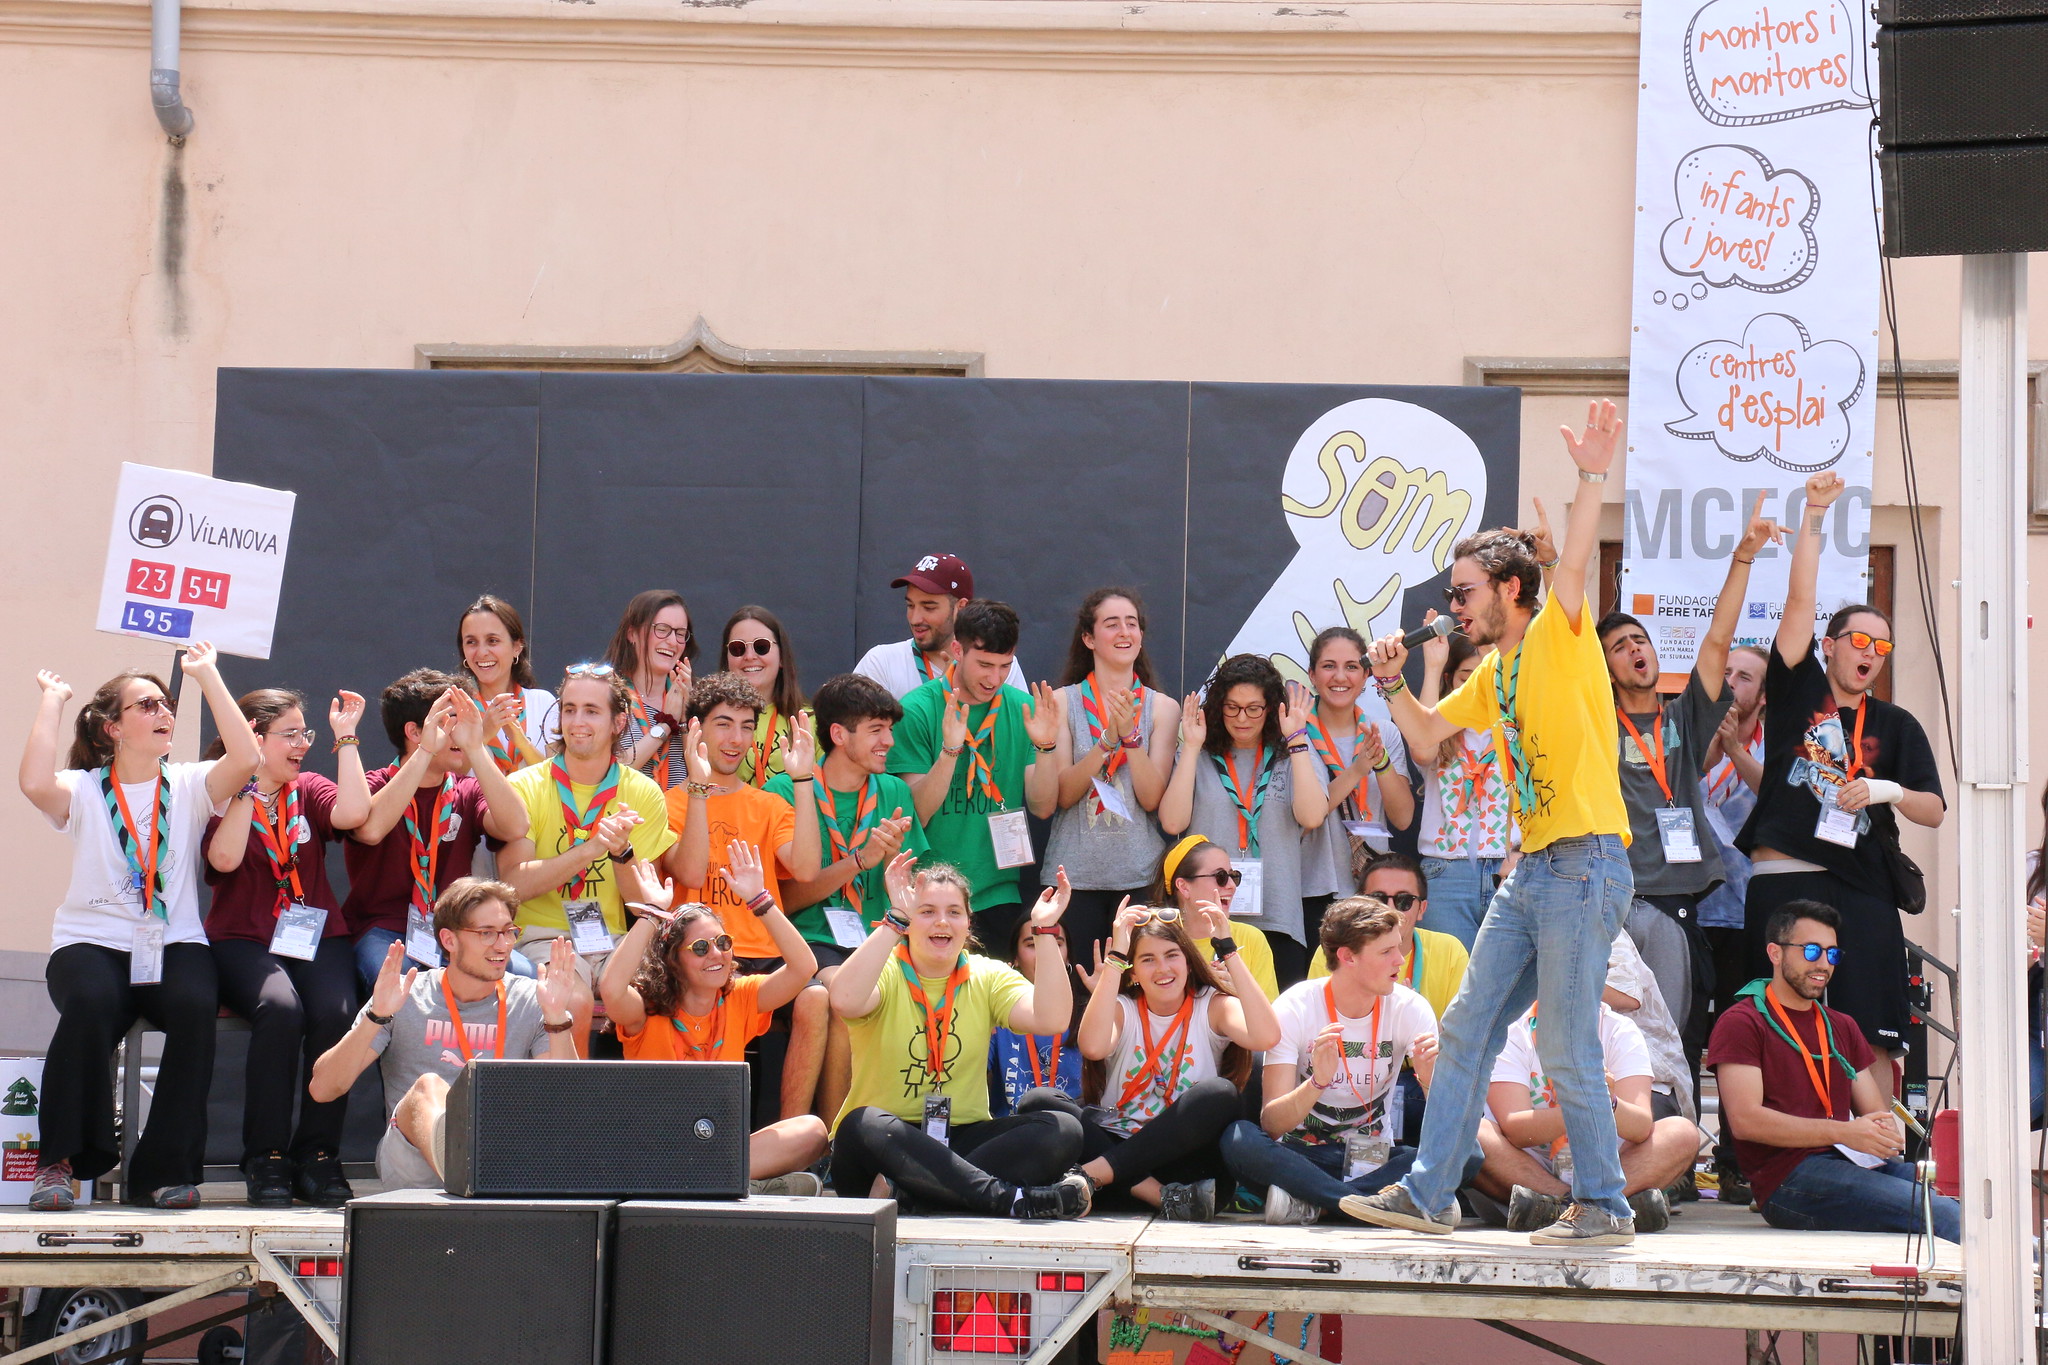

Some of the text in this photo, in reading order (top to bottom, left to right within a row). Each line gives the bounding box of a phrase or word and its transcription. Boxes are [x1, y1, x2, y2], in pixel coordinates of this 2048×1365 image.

[1699, 4, 1837, 52] monitors i
[1710, 52, 1848, 99] monitores
[1699, 170, 1795, 228] infants
[1684, 217, 1775, 271] i joves!
[1709, 343, 1796, 382] centres
[1717, 377, 1827, 452] d'esplai
[135, 566, 222, 603] 23 54
[127, 608, 173, 633] L95
[1658, 607, 1690, 617] PERE
[1732, 636, 1771, 645] NDACIÓ
[424, 1019, 498, 1051] PUMA
[1331, 1072, 1381, 1085] URLEY
